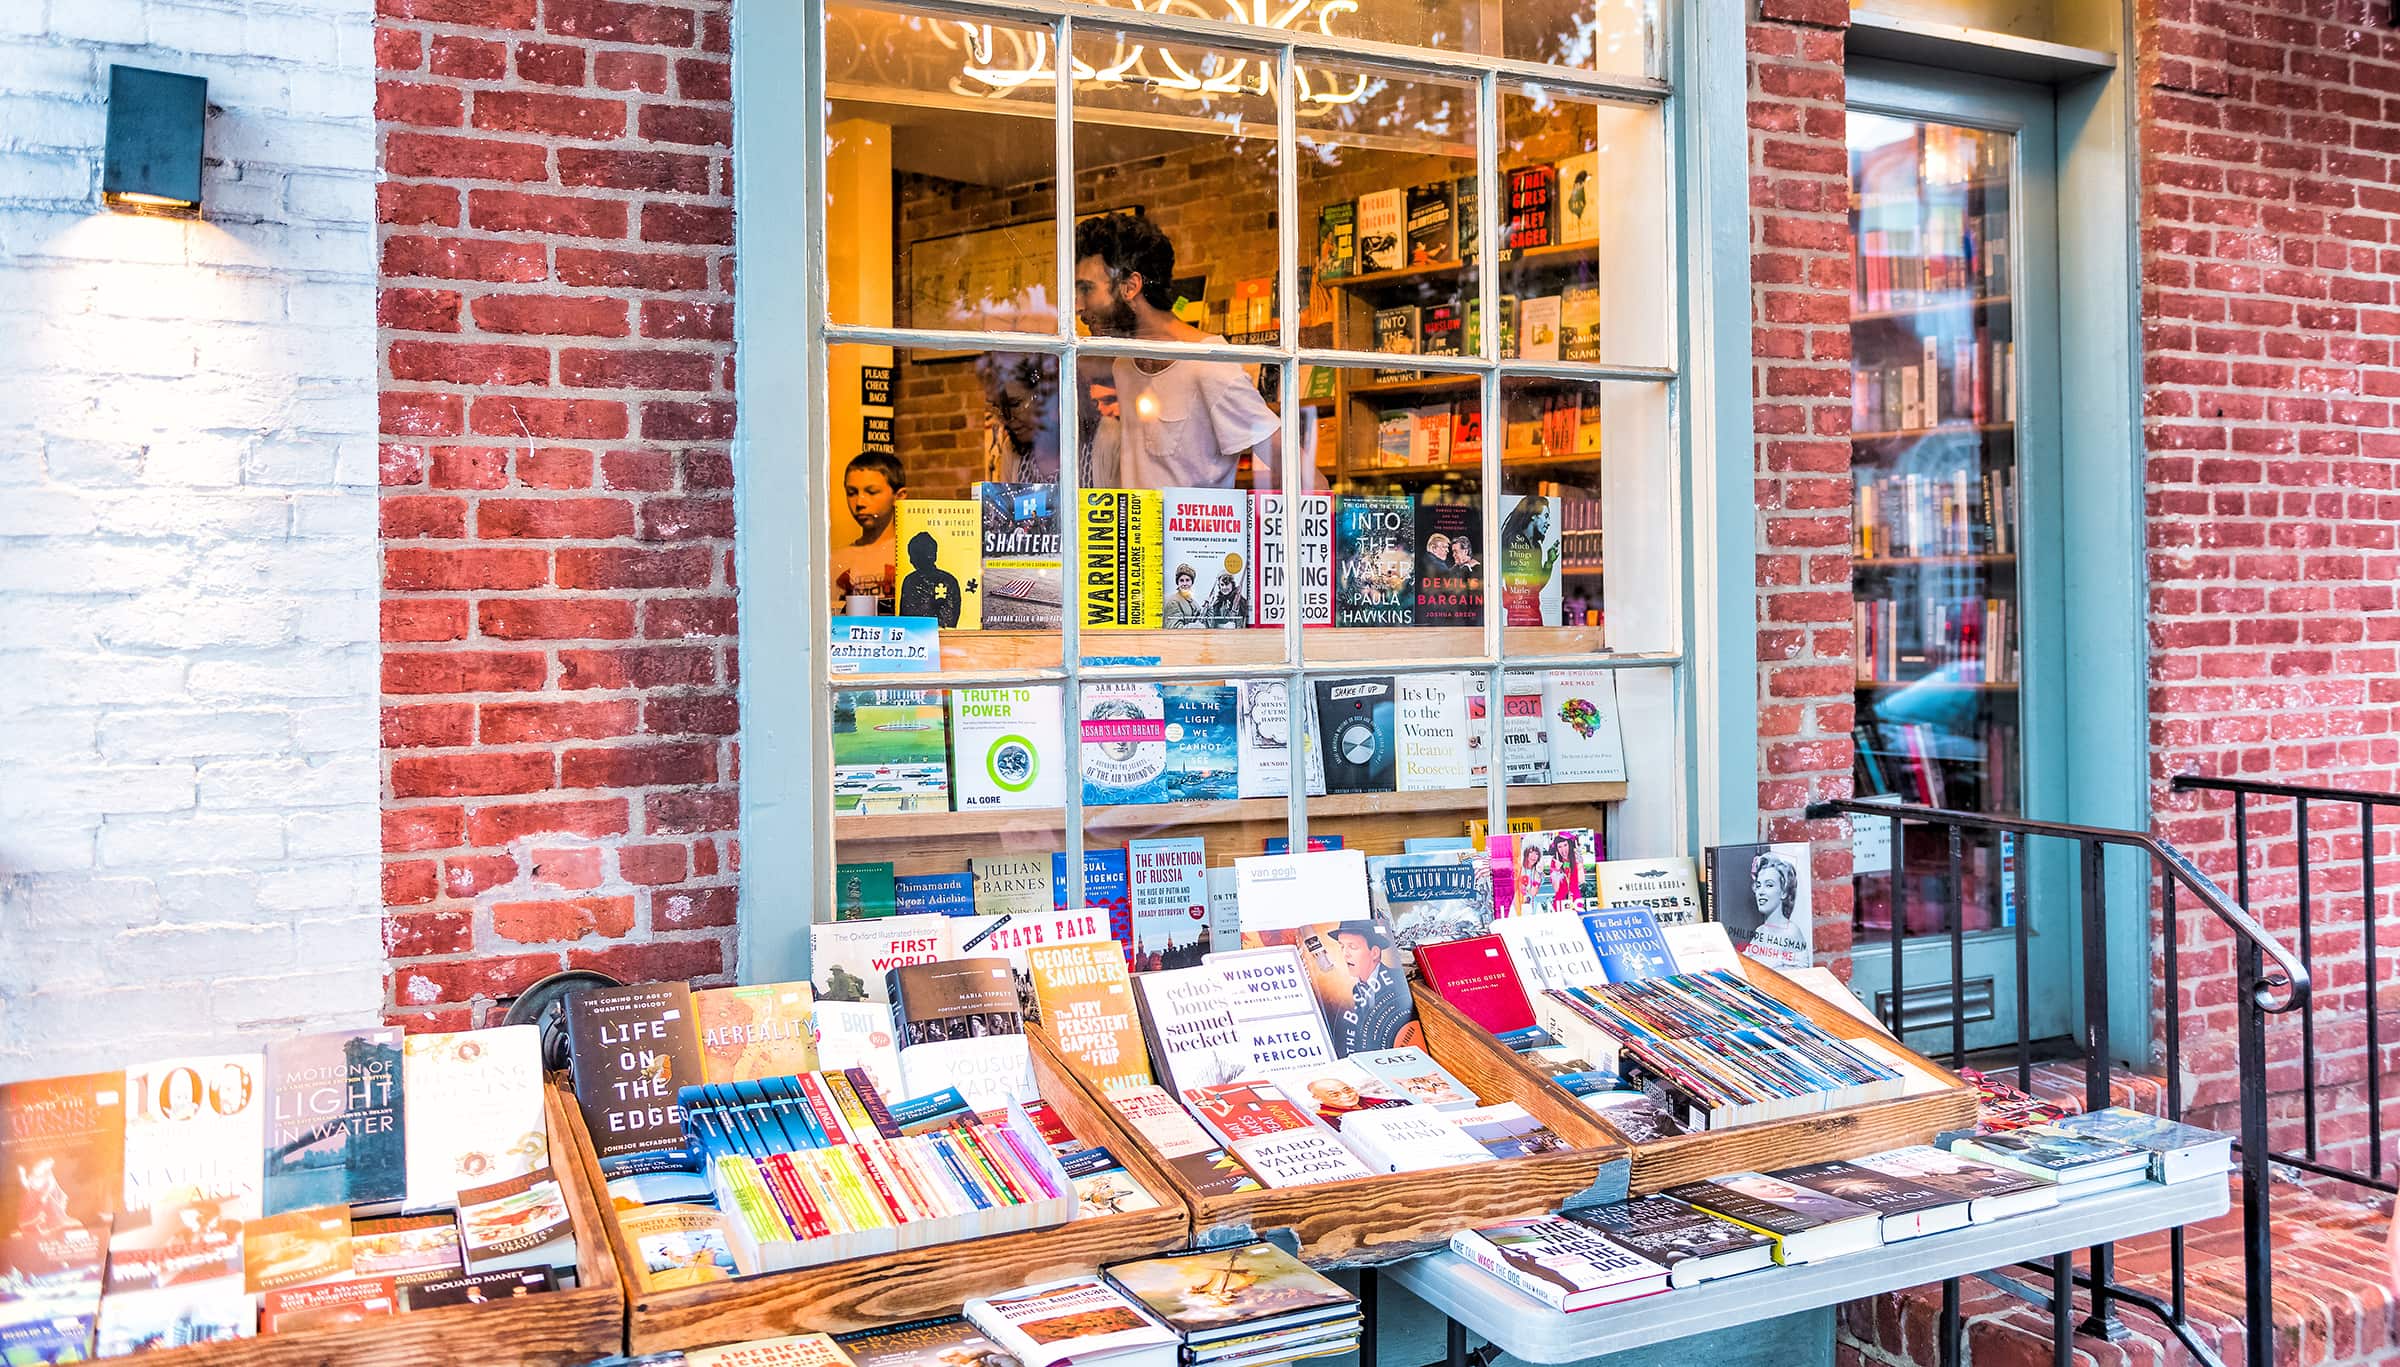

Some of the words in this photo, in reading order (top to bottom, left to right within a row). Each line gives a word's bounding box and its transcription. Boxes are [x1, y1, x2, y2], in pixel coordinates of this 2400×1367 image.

[1513, 171, 1546, 191] FINAL
[1513, 189, 1546, 208] GIRLS
[1379, 315, 1406, 329] INTO
[865, 369, 889, 379] PLEASE
[866, 380, 889, 391] CHECK
[869, 392, 886, 402] BAGS
[870, 420, 888, 430] MORE
[868, 431, 890, 442] BOOKS
[1177, 504, 1234, 517] SVETLANA
[1169, 519, 1241, 533] ALEXIEVICH
[1352, 512, 1400, 530] INTO
[1356, 537, 1396, 553] THE
[1088, 493, 1114, 625] WARNINGS
[1131, 546, 1141, 578] CLARKE
[1509, 550, 1531, 559] Things
[1423, 577, 1479, 588] DEVIL'S
[1354, 592, 1400, 605] PAULA
[1417, 595, 1483, 605] BARGAIN
[1343, 610, 1412, 624] HAWKINS
[850, 628, 880, 640] This
[891, 629, 903, 641] is
[962, 689, 1008, 702] TRUTH
[1013, 689, 1030, 702] TO
[1335, 687, 1355, 698] SHAKE
[1358, 686, 1365, 695] IT
[1368, 686, 1378, 694] UP
[1403, 688, 1421, 700] It's
[1426, 688, 1445, 704] Up
[962, 704, 1011, 717] POWER
[1178, 703, 1197, 711] ALL
[1201, 702, 1220, 711] THE
[1404, 708, 1416, 719] to
[1421, 706, 1440, 719] the
[1185, 715, 1216, 724] LIGHT
[1111, 724, 1130, 736] LAST
[1193, 729, 1208, 737] WE
[1405, 724, 1454, 737] Women
[1179, 743, 1221, 751] CANNOT
[1406, 743, 1452, 756] Eleanor
[966, 796, 977, 805] AL
[980, 795, 1001, 804] GORE
[1512, 822, 1533, 832] KLEIN
[1136, 854, 1152, 867] THE
[1156, 852, 1202, 866] INVENTION
[985, 862, 1041, 879] JULIAN
[1136, 870, 1148, 884] OF
[1151, 868, 1183, 883] RUSSIA
[1251, 869, 1270, 878] van
[1272, 865, 1297, 881] gogh
[896, 880, 962, 892] Chimamanda
[983, 878, 1045, 893] BARNES
[1408, 873, 1441, 889] UNION
[1625, 881, 1657, 891] MICHAEL
[897, 895, 925, 907] Ngozi
[929, 894, 966, 905] Adichie
[1683, 896, 1696, 906] S.
[1593, 919, 1607, 928] The
[1608, 917, 1622, 927] Best
[1632, 915, 1643, 924] the
[834, 933, 848, 942] The
[849, 930, 876, 941] Oxford
[990, 925, 1043, 951] STATE
[1056, 916, 1097, 939] FAIR
[1593, 926, 1653, 943] HARVARD
[1727, 926, 1764, 941] PHILIPPE
[1767, 934, 1807, 951] HALSMAN
[890, 938, 938, 954] FIRST
[1521, 940, 1585, 960] THIRD
[1598, 939, 1660, 958] LAMPOON
[1034, 946, 1091, 970] GEORGE
[1046, 962, 1125, 988] SAUNDERS
[1223, 964, 1295, 981] WINDOWS
[1529, 961, 1595, 980] REICH
[1248, 978, 1297, 993] WORLD
[1447, 976, 1483, 988] SPORTING
[1484, 972, 1507, 983] GUIDE
[594, 1004, 631, 1013] QUANTUM
[634, 1001, 666, 1010] BIOLOGY
[600, 996, 631, 1004] COMING
[1172, 997, 1229, 1016] bones
[1055, 1010, 1072, 1020] The
[1070, 1000, 1102, 1018] VERY
[1057, 1014, 1129, 1036] PERSISTENT
[1166, 1010, 1234, 1035] samuel
[600, 1020, 667, 1044] LIFE
[707, 1018, 815, 1046] AEREALITY
[1253, 1030, 1311, 1046] MATTEO
[1060, 1031, 1118, 1053] GAPPERS
[1165, 1029, 1239, 1055] beckett
[620, 1049, 655, 1071] ON
[1081, 1052, 1091, 1062] of
[1092, 1047, 1120, 1066] FRIP
[1253, 1046, 1322, 1063] PERICOLI
[1374, 1054, 1418, 1066] CATS
[286, 1063, 361, 1083] MOTION
[368, 1060, 393, 1073] OF
[128, 1063, 252, 1121] 100
[612, 1076, 670, 1101] THE
[275, 1081, 393, 1120] LIGHT
[609, 1105, 681, 1132] EDGE
[1381, 1118, 1432, 1131] BLUE
[275, 1127, 299, 1146] IN
[311, 1115, 393, 1140] WATER
[1388, 1126, 1446, 1142] MIND
[603, 1143, 637, 1153] JOHNJOE
[639, 1139, 677, 1148] MCFADDEN
[1255, 1138, 1325, 1157] MARIO
[1259, 1146, 1343, 1169] VARGAS
[1277, 1158, 1346, 1178] LLOSA
[1784, 1170, 1821, 1182] DEAD
[1852, 1189, 1935, 1208] LARSON
[628, 1218, 664, 1229] NORTH
[667, 1215, 720, 1223] AMERICAN
[640, 1223, 678, 1233] INDIAN
[1524, 1220, 1570, 1236] THE
[1536, 1228, 1585, 1247] TAIL
[1537, 1238, 1605, 1258] WAGS
[1578, 1247, 1622, 1262] THE
[1477, 1251, 1495, 1272] WAGS
[1590, 1256, 1641, 1272] DOG
[424, 1275, 482, 1293] EDOUARD
[483, 1270, 525, 1283] MANET
[280, 1291, 311, 1302] Tales
[331, 1281, 382, 1295] Mystery
[995, 1300, 1046, 1314] Modern
[1048, 1287, 1109, 1304] American
[836, 1328, 889, 1341] GEORGE
[847, 1326, 973, 1354] FRANKLIN
[720, 1340, 824, 1360] AMERICAN
